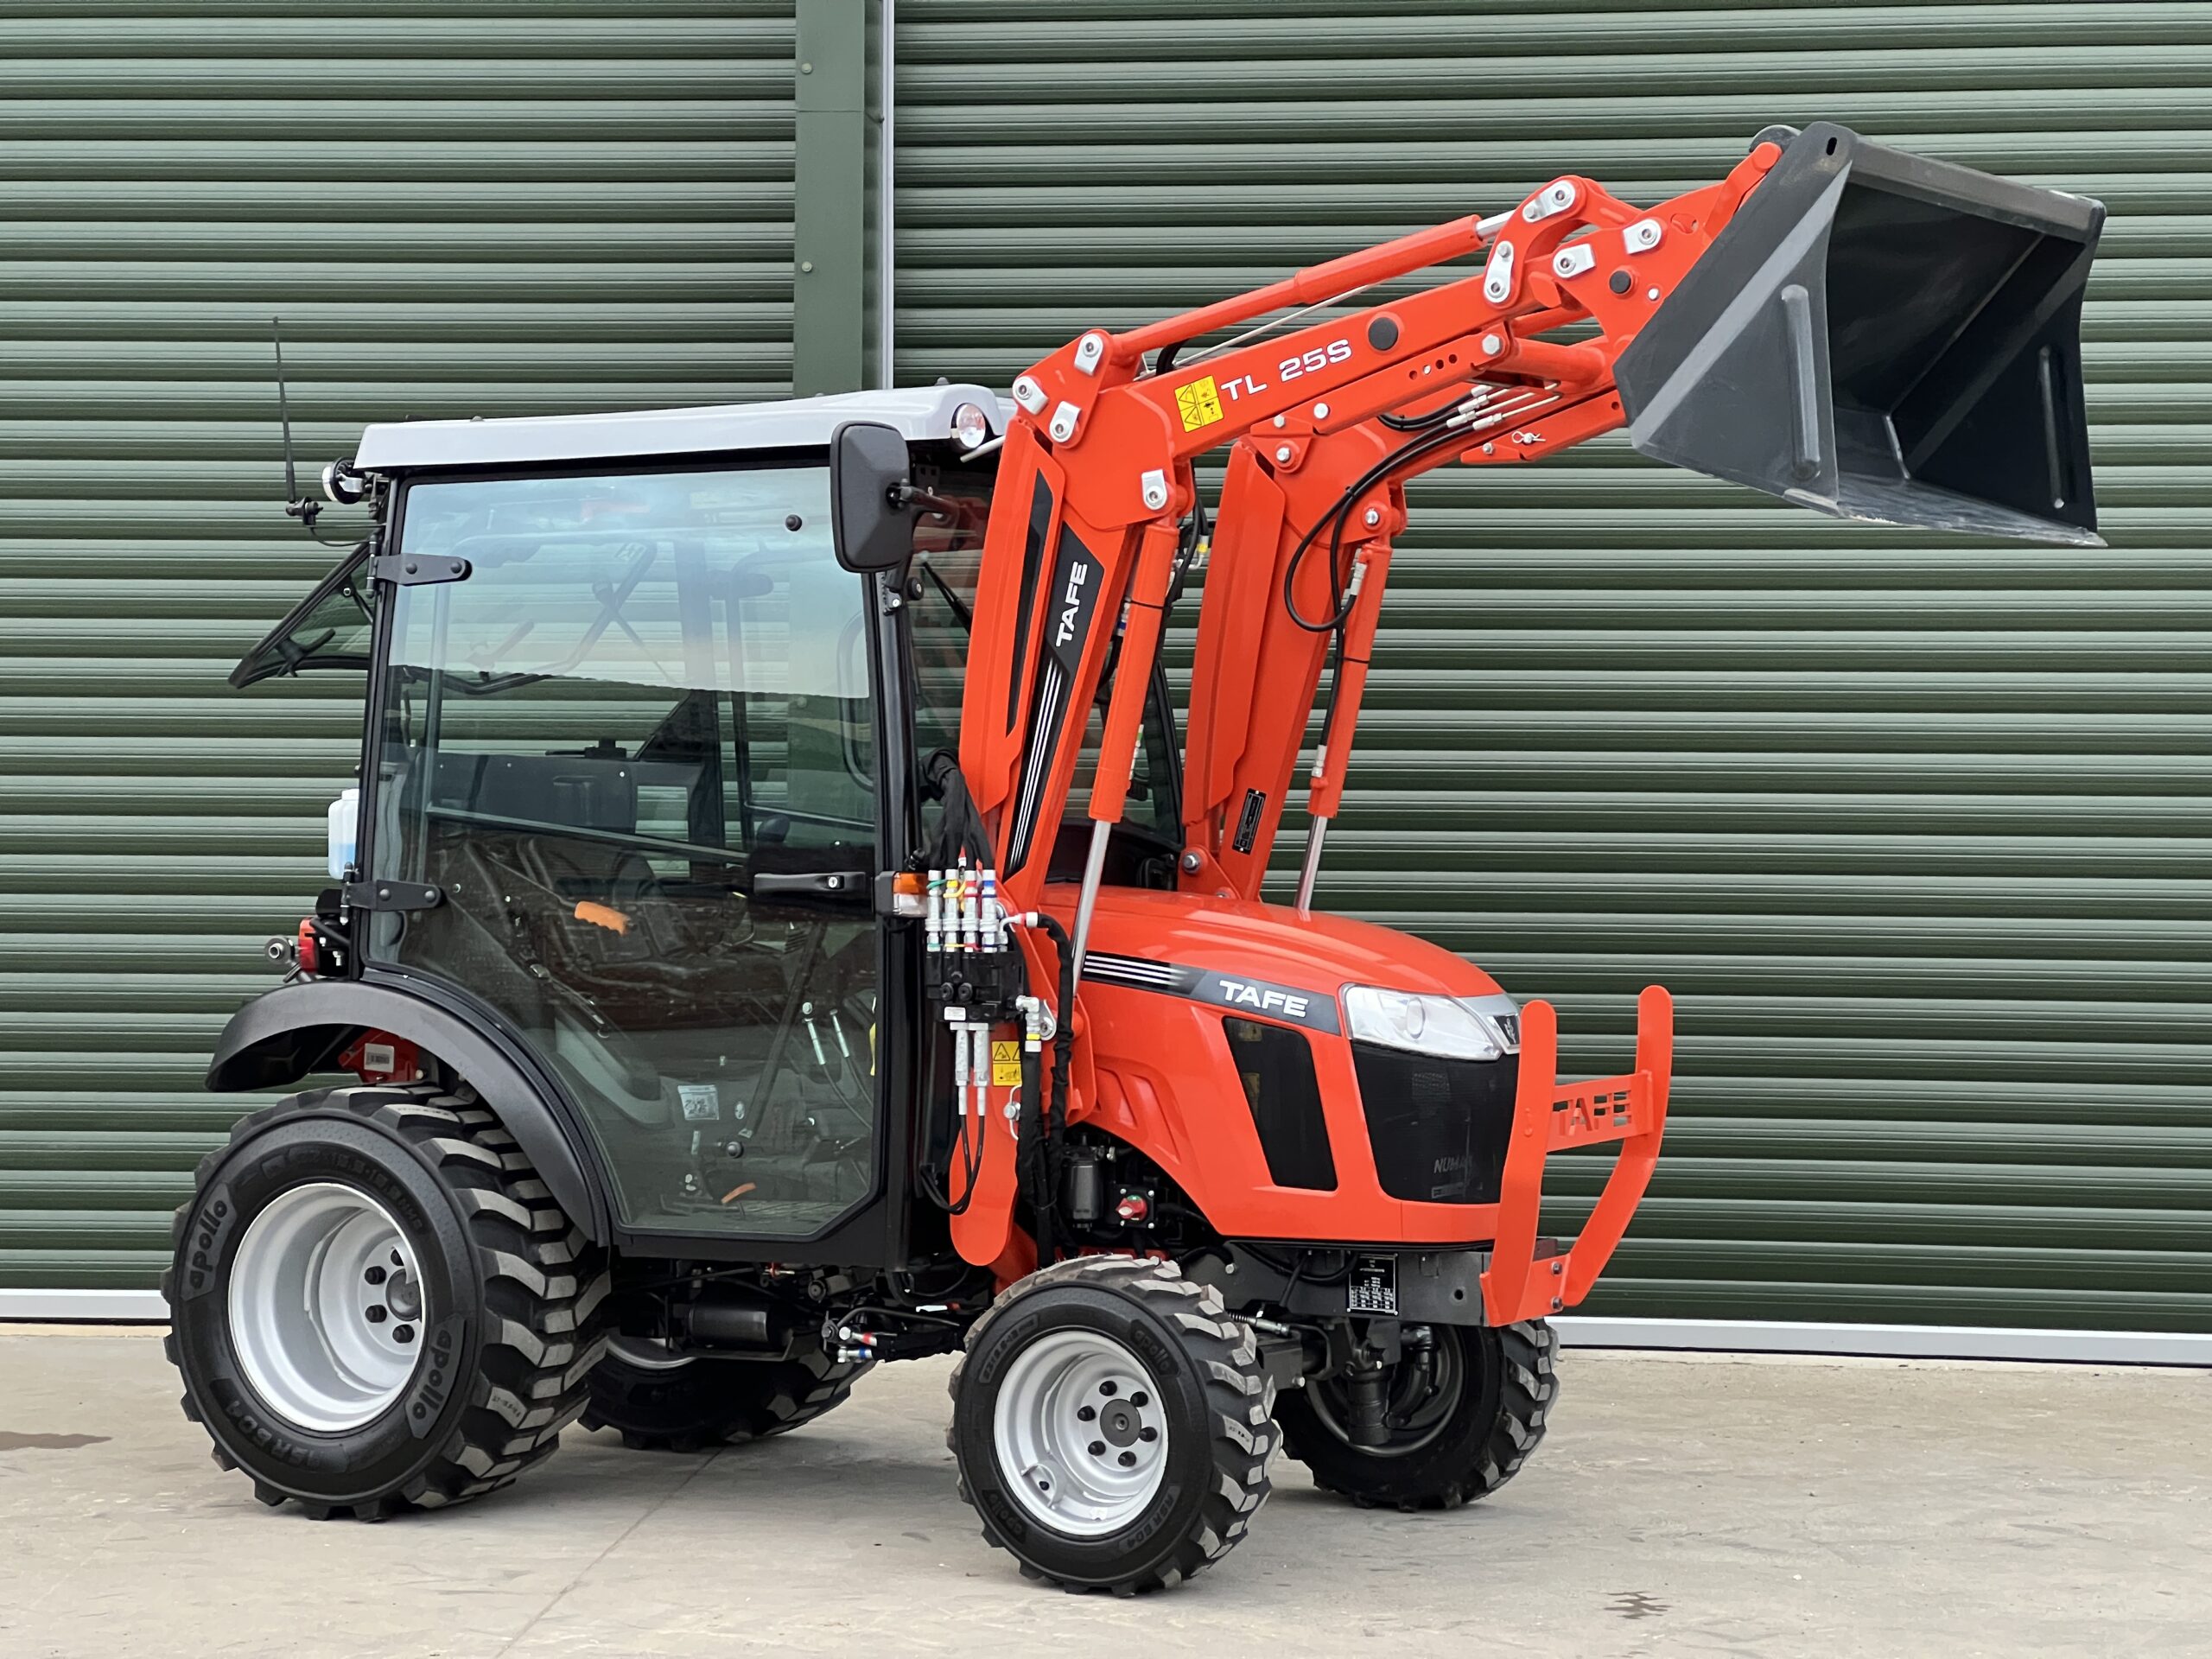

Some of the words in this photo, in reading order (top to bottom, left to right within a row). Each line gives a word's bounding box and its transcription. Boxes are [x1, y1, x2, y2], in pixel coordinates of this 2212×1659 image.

[1220, 374, 1268, 401] TL
[1278, 339, 1353, 382] 25S
[1055, 561, 1089, 647] TAFE
[1219, 980, 1309, 1018] TAFE
[1552, 1090, 1632, 1136] TAFE
[188, 1198, 227, 1291] apollo
[410, 1329, 451, 1421] apollo
[1134, 1328, 1171, 1375] apollo
[988, 1492, 1025, 1538] apollo
